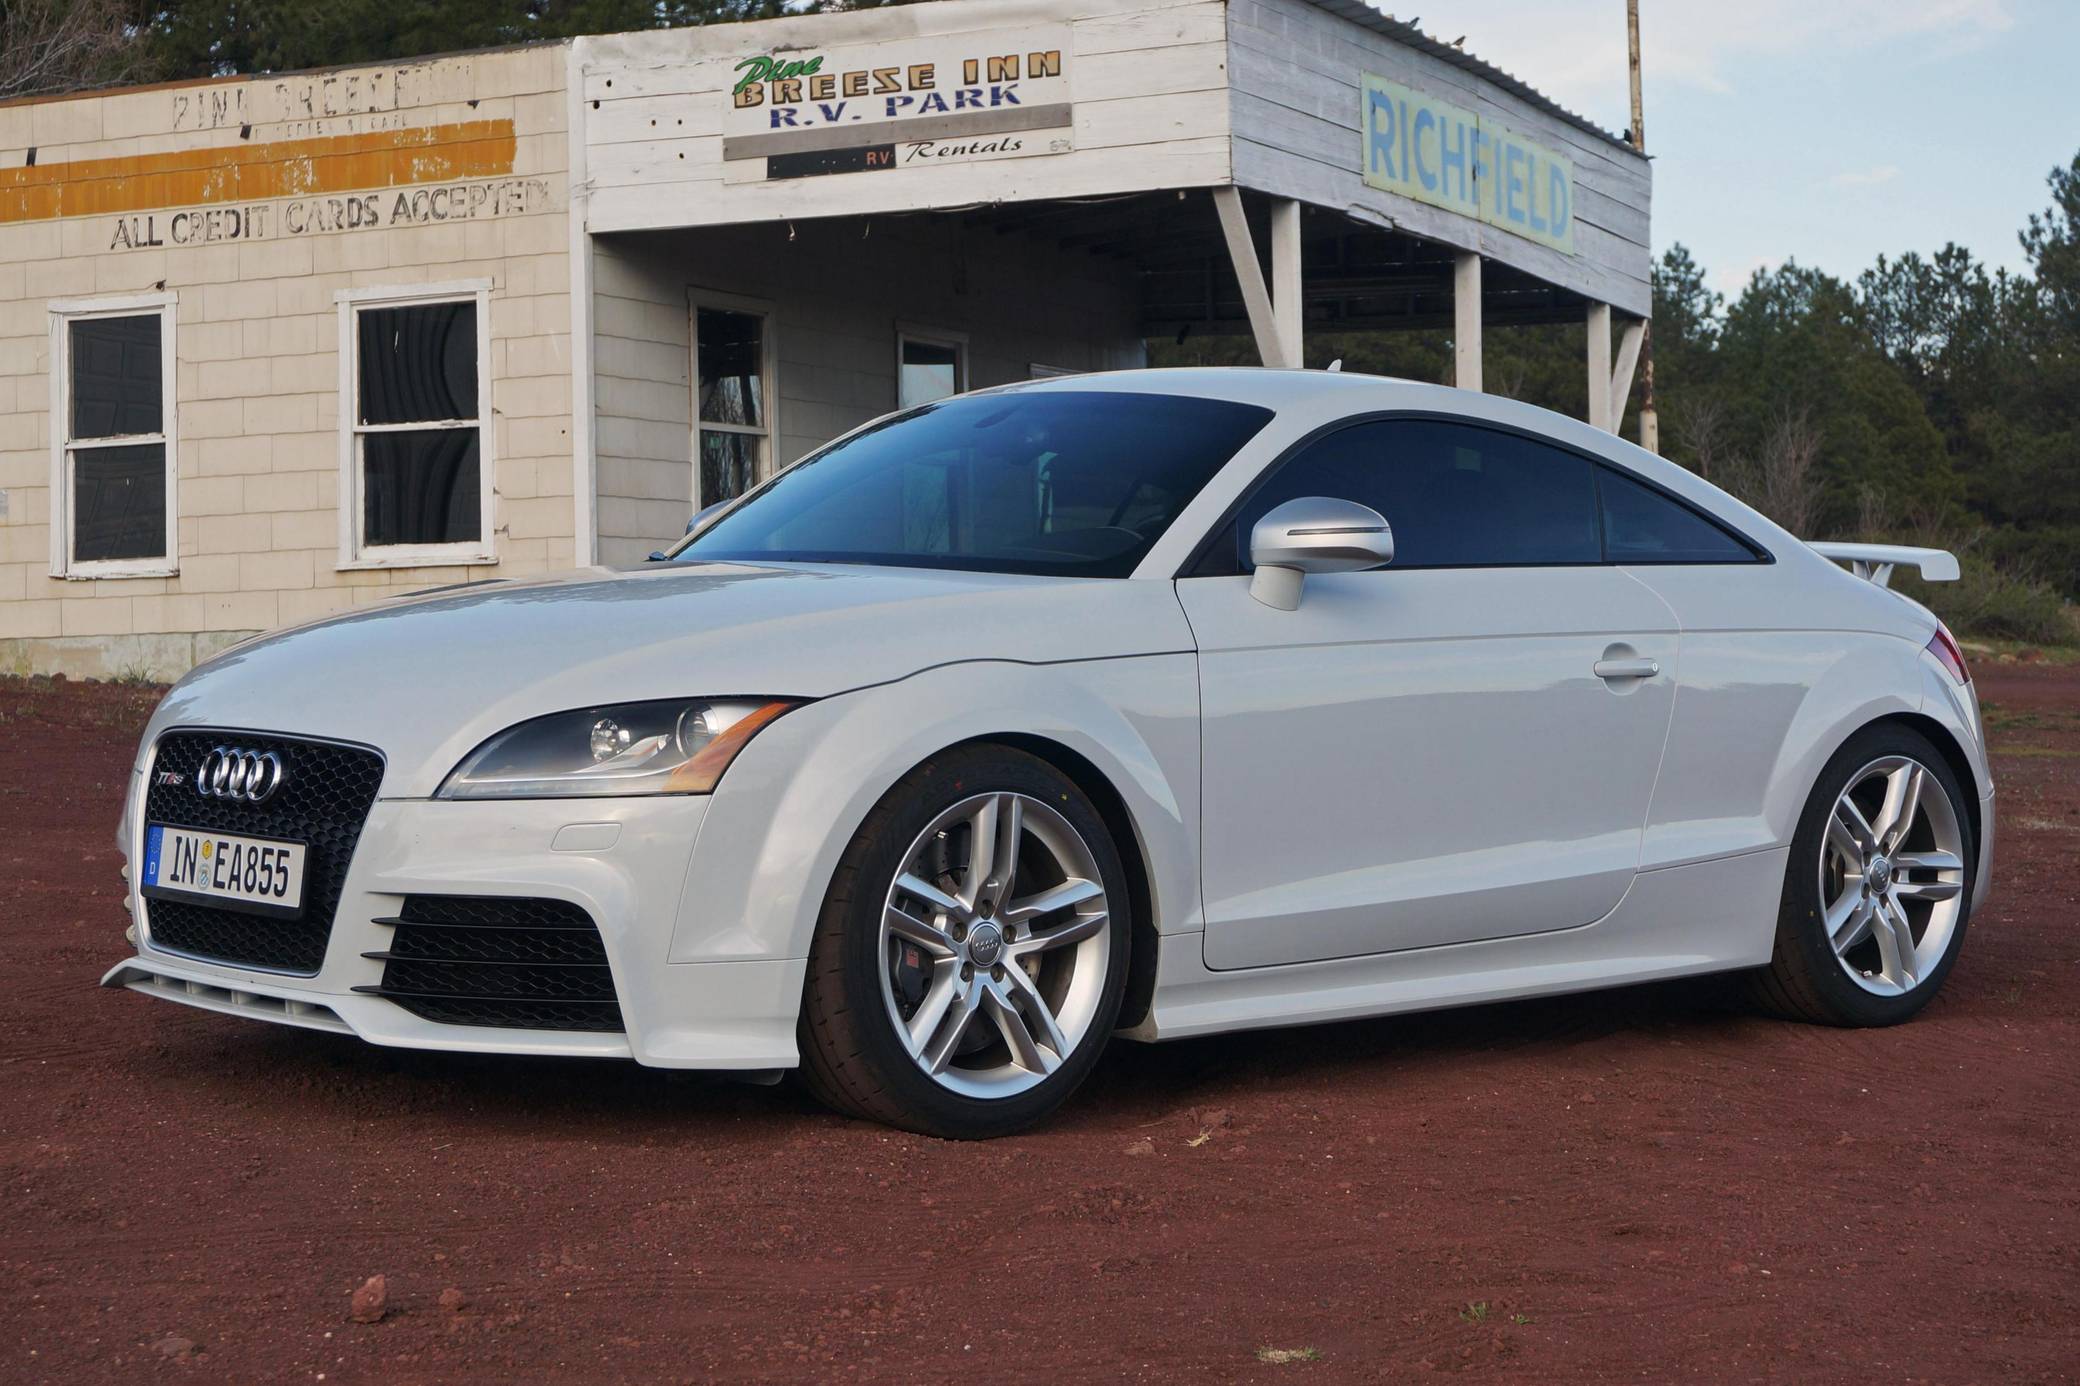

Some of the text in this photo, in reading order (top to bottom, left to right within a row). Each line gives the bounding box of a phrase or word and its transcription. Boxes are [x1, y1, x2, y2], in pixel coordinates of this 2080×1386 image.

[732, 56, 824, 95] Pine
[735, 50, 1061, 109] BREEZE INN
[770, 84, 1021, 128] R.V. PARK
[867, 137, 1023, 165] RV Rentals
[1369, 88, 1569, 239] RICHFIELD
[110, 179, 549, 250] ALL CREDIT CARDS ACCEPTED
[150, 836, 290, 897] D IN EA855
